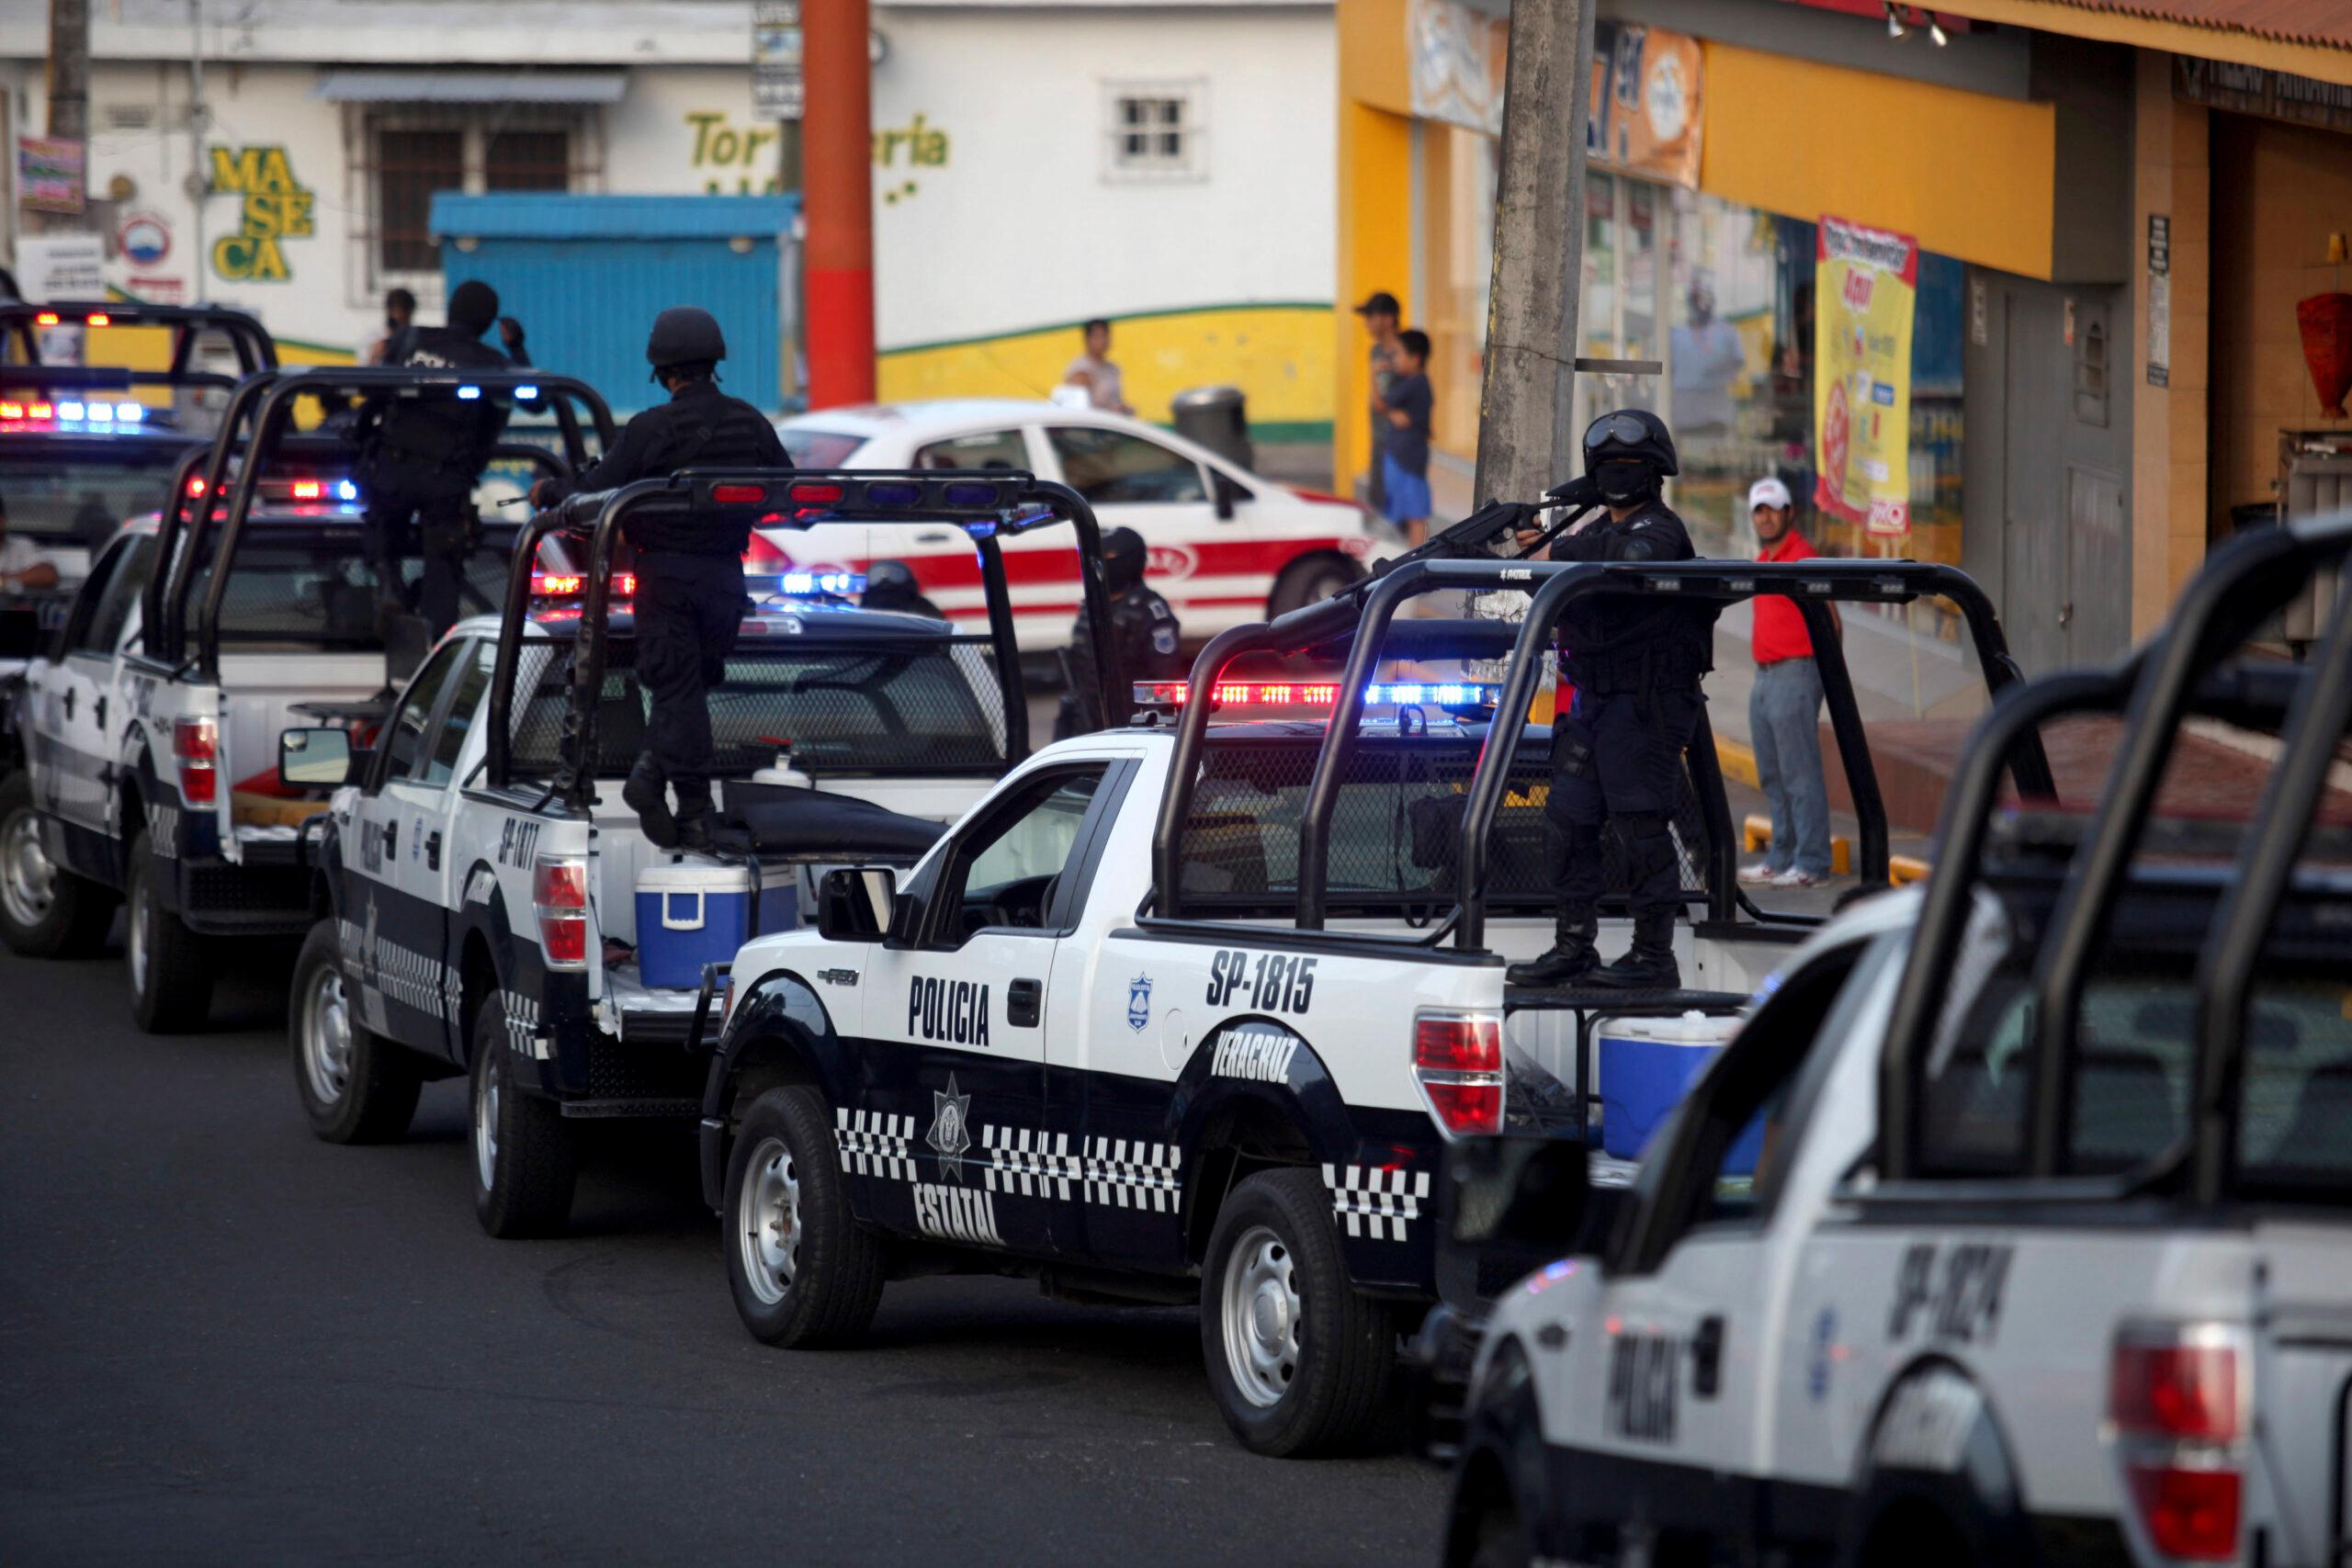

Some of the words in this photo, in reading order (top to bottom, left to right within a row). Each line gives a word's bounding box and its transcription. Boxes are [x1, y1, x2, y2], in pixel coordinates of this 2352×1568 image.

[210, 146, 299, 193] MA
[243, 189, 314, 240] SE
[212, 236, 293, 282] CA
[1205, 949, 1318, 1015] SP-1815
[908, 975, 989, 1047] POLICIA
[1211, 1030, 1300, 1085] VERACRUZ
[912, 1182, 1008, 1247] ESTATAL
